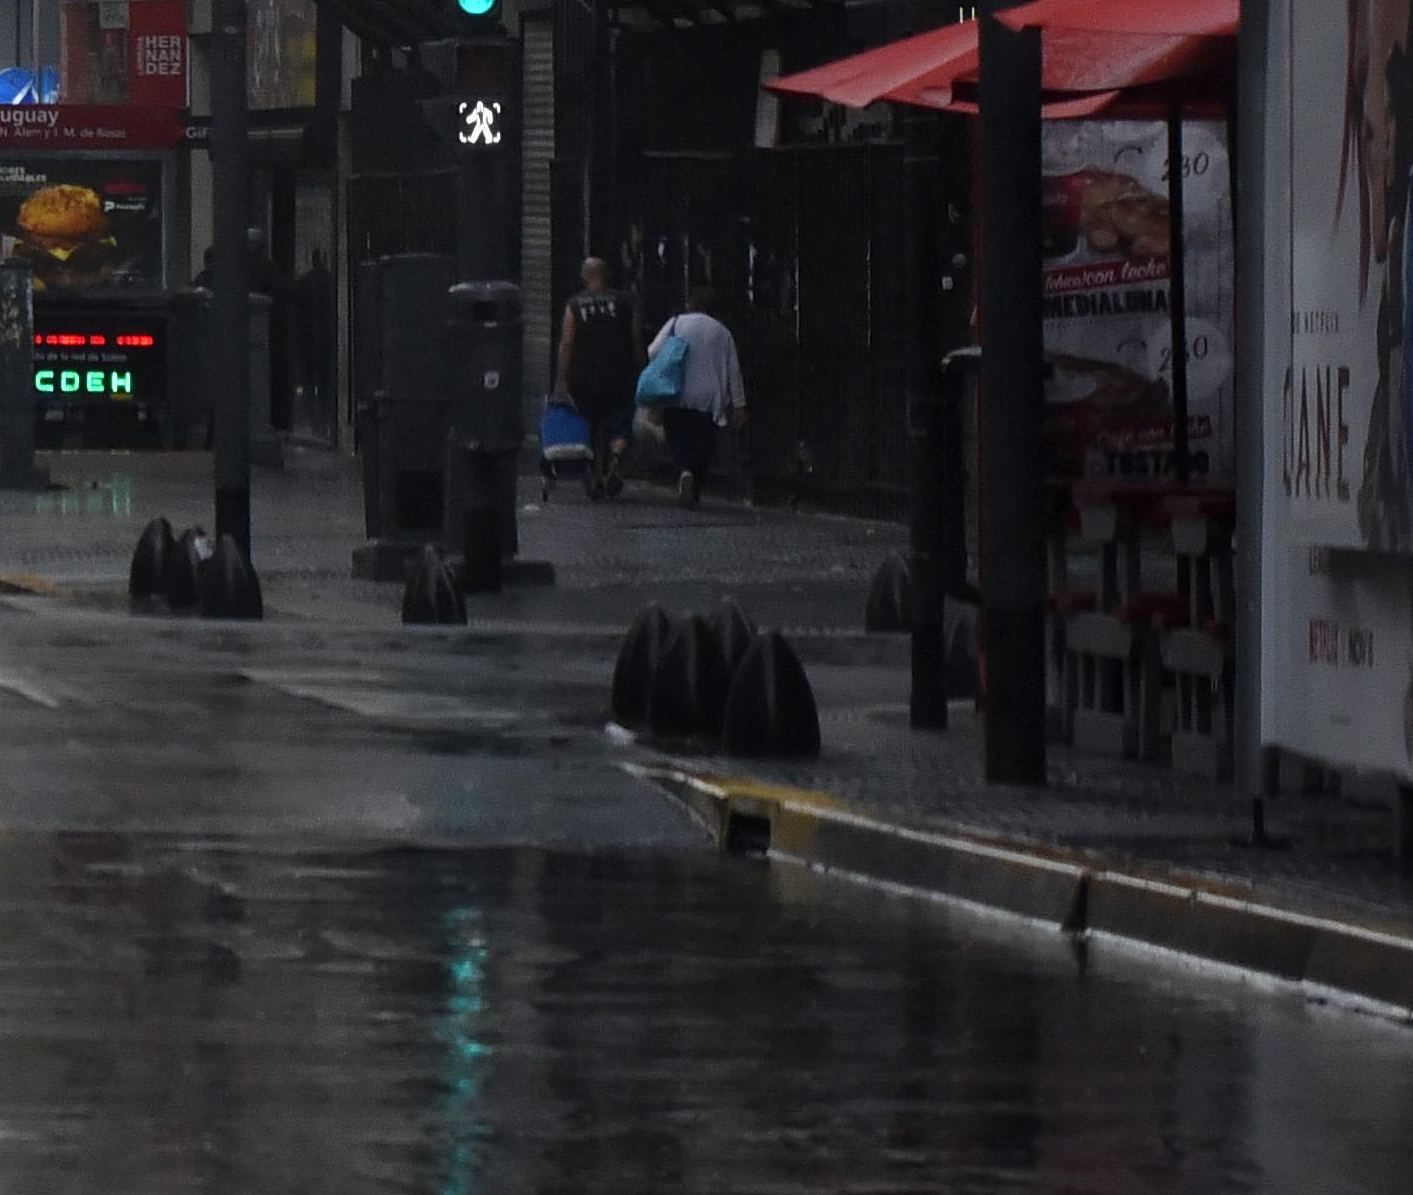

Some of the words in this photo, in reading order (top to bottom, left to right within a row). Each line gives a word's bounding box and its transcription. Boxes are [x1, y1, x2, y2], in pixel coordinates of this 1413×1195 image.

[146, 35, 182, 49] HER
[146, 49, 182, 62] NAN
[146, 62, 182, 75] DEZ
